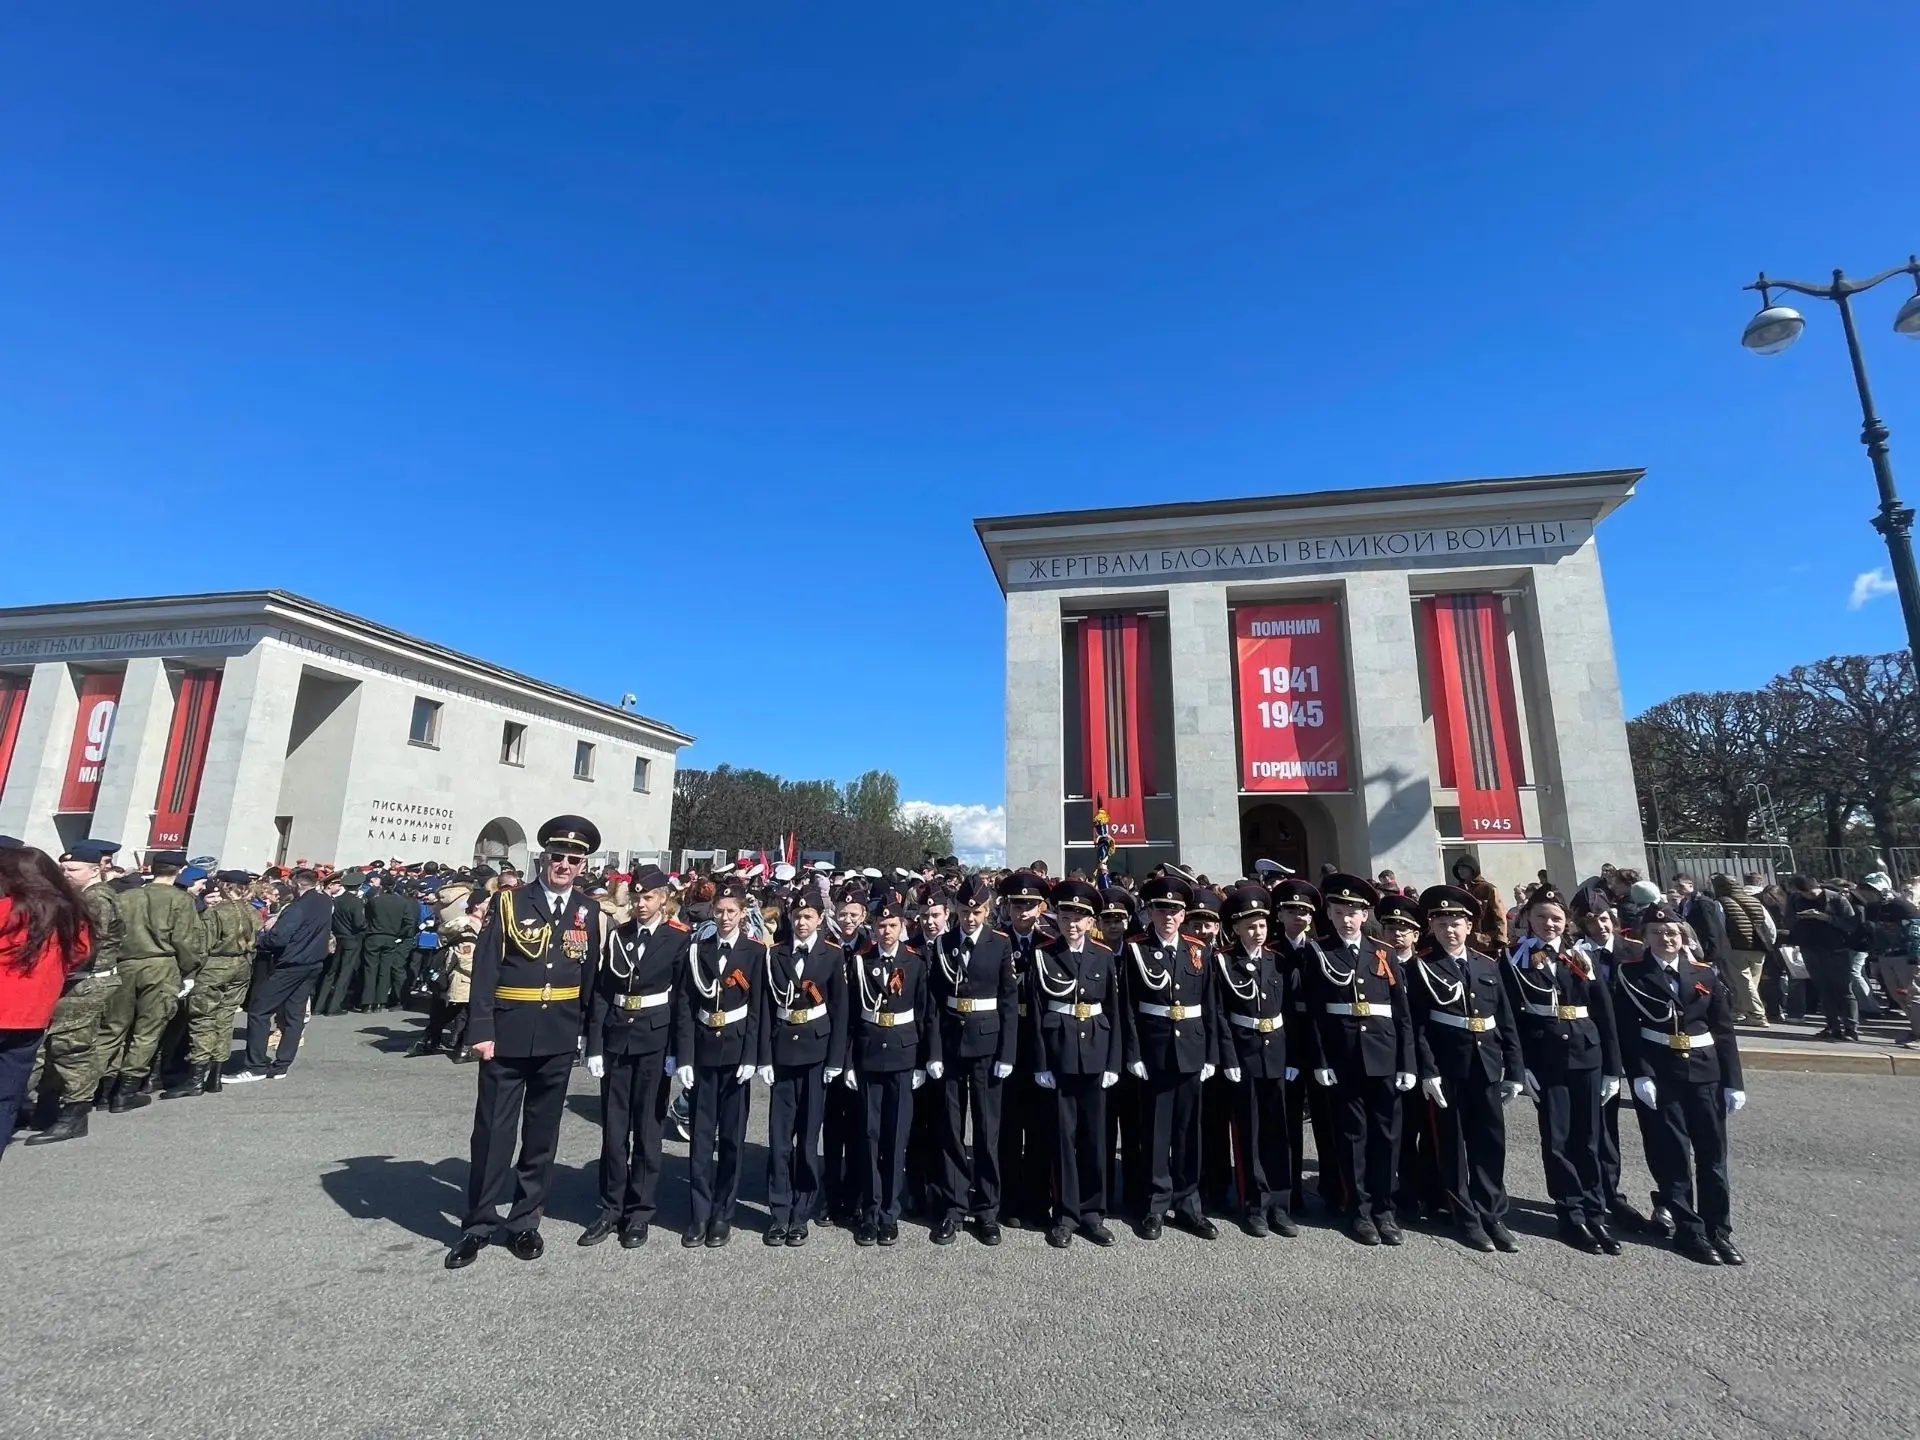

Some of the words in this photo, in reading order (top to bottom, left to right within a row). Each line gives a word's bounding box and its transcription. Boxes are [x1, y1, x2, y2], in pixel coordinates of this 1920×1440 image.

[1029, 553, 1149, 578] ЖЕРТВАМ
[1161, 543, 1288, 570] БЛОКАДЫ
[1298, 530, 1435, 561] ВЕЛИКОЙ
[1446, 522, 1566, 550] ВОЙНЫ
[1251, 618, 1321, 637] ПОМНИМ
[0, 638, 85, 656] ЕЗЗАВЕТНЫМ
[191, 627, 251, 646] НАШИМ
[278, 630, 355, 666] ПАМЯТЬ
[362, 655, 375, 672] О
[380, 661, 411, 684] ВАС
[1258, 665, 1320, 694] 1941
[1258, 700, 1324, 728] 1945
[85, 700, 118, 762] 9
[1252, 760, 1338, 779] ГОРДИМСЯ
[372, 799, 454, 819] ПИСКАРЕВСКОЕ
[370, 815, 453, 831] МЕМОРИАЛЬНОЕ
[1472, 818, 1512, 830] 1945
[158, 833, 179, 842] 1945
